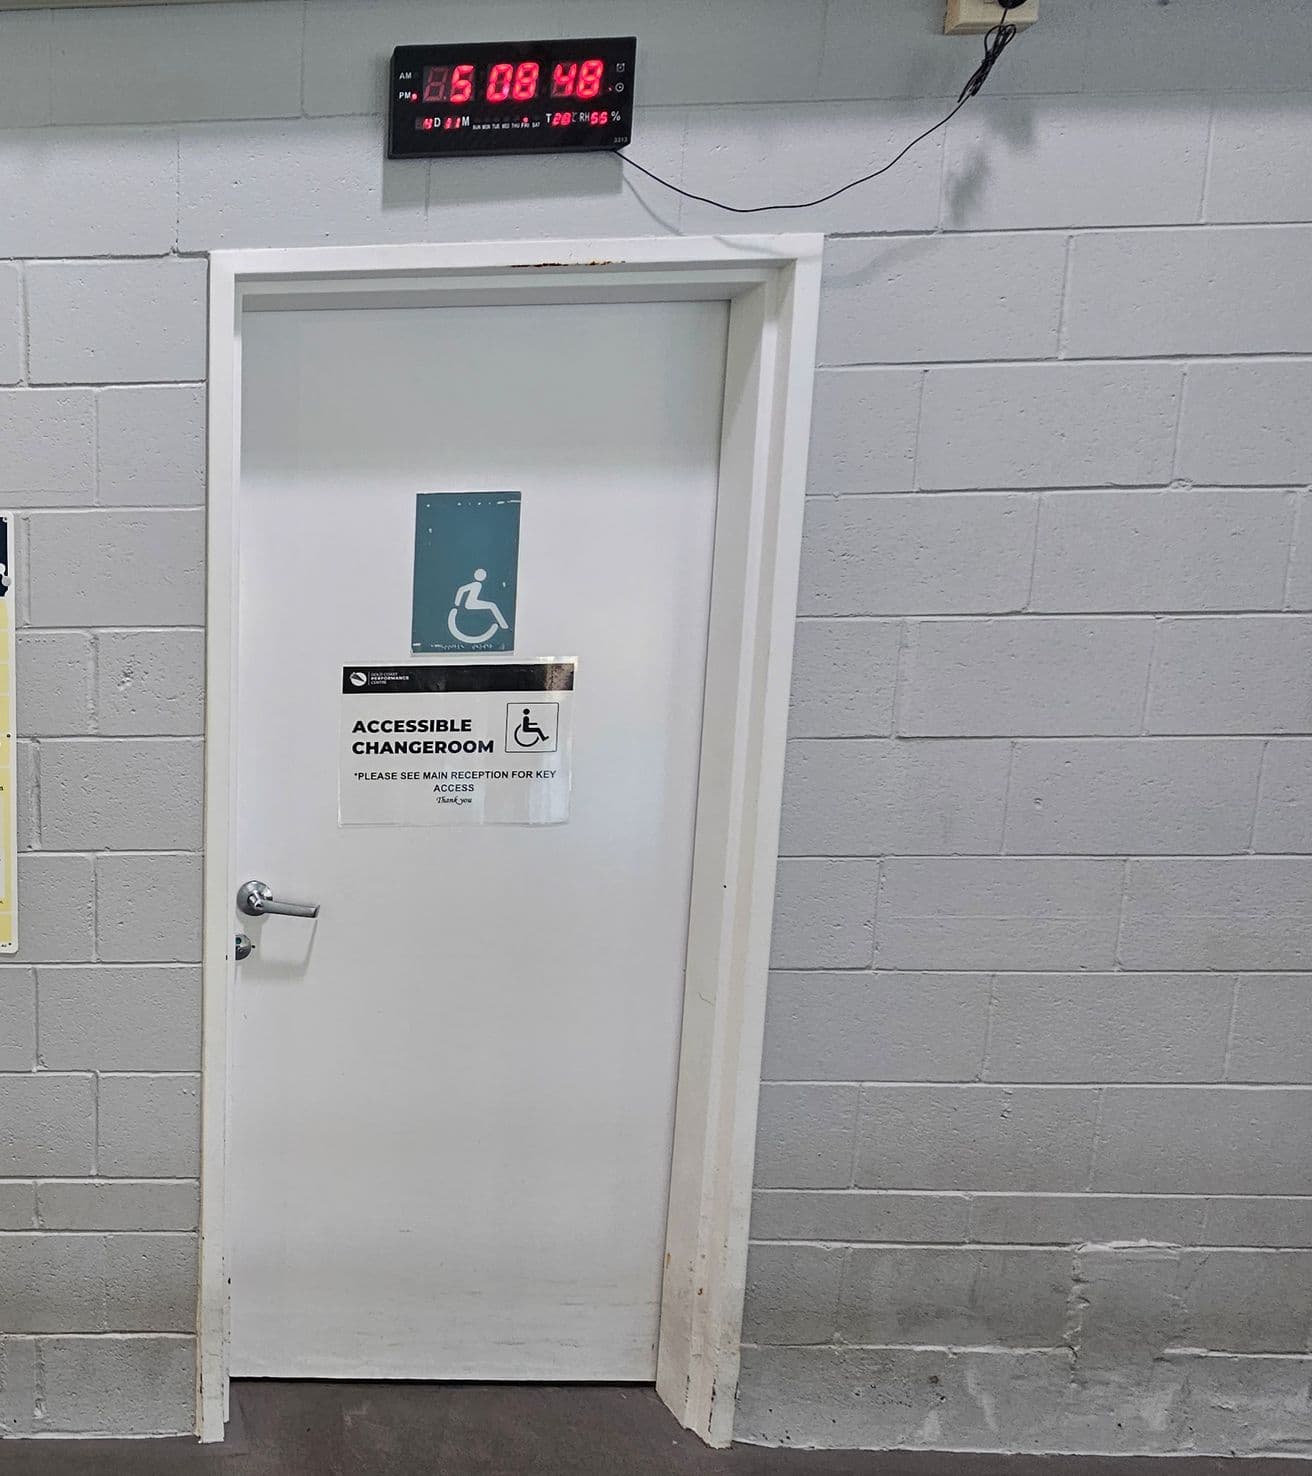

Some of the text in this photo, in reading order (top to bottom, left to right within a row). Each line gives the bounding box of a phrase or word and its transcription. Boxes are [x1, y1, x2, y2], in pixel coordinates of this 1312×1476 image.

[399, 72, 412, 80] AM
[450, 60, 603, 103] 5 08 48
[353, 719, 472, 734] ACCESSIBLE
[353, 740, 494, 755] CHANGEROOM
[401, 771, 420, 780] SEE
[423, 772, 448, 780] MAIN
[451, 771, 509, 779] RECEPTION
[511, 771, 533, 779] FOR
[536, 770, 555, 779] KEY
[434, 784, 474, 793] ACCESS
[436, 796, 473, 805] Thank you
